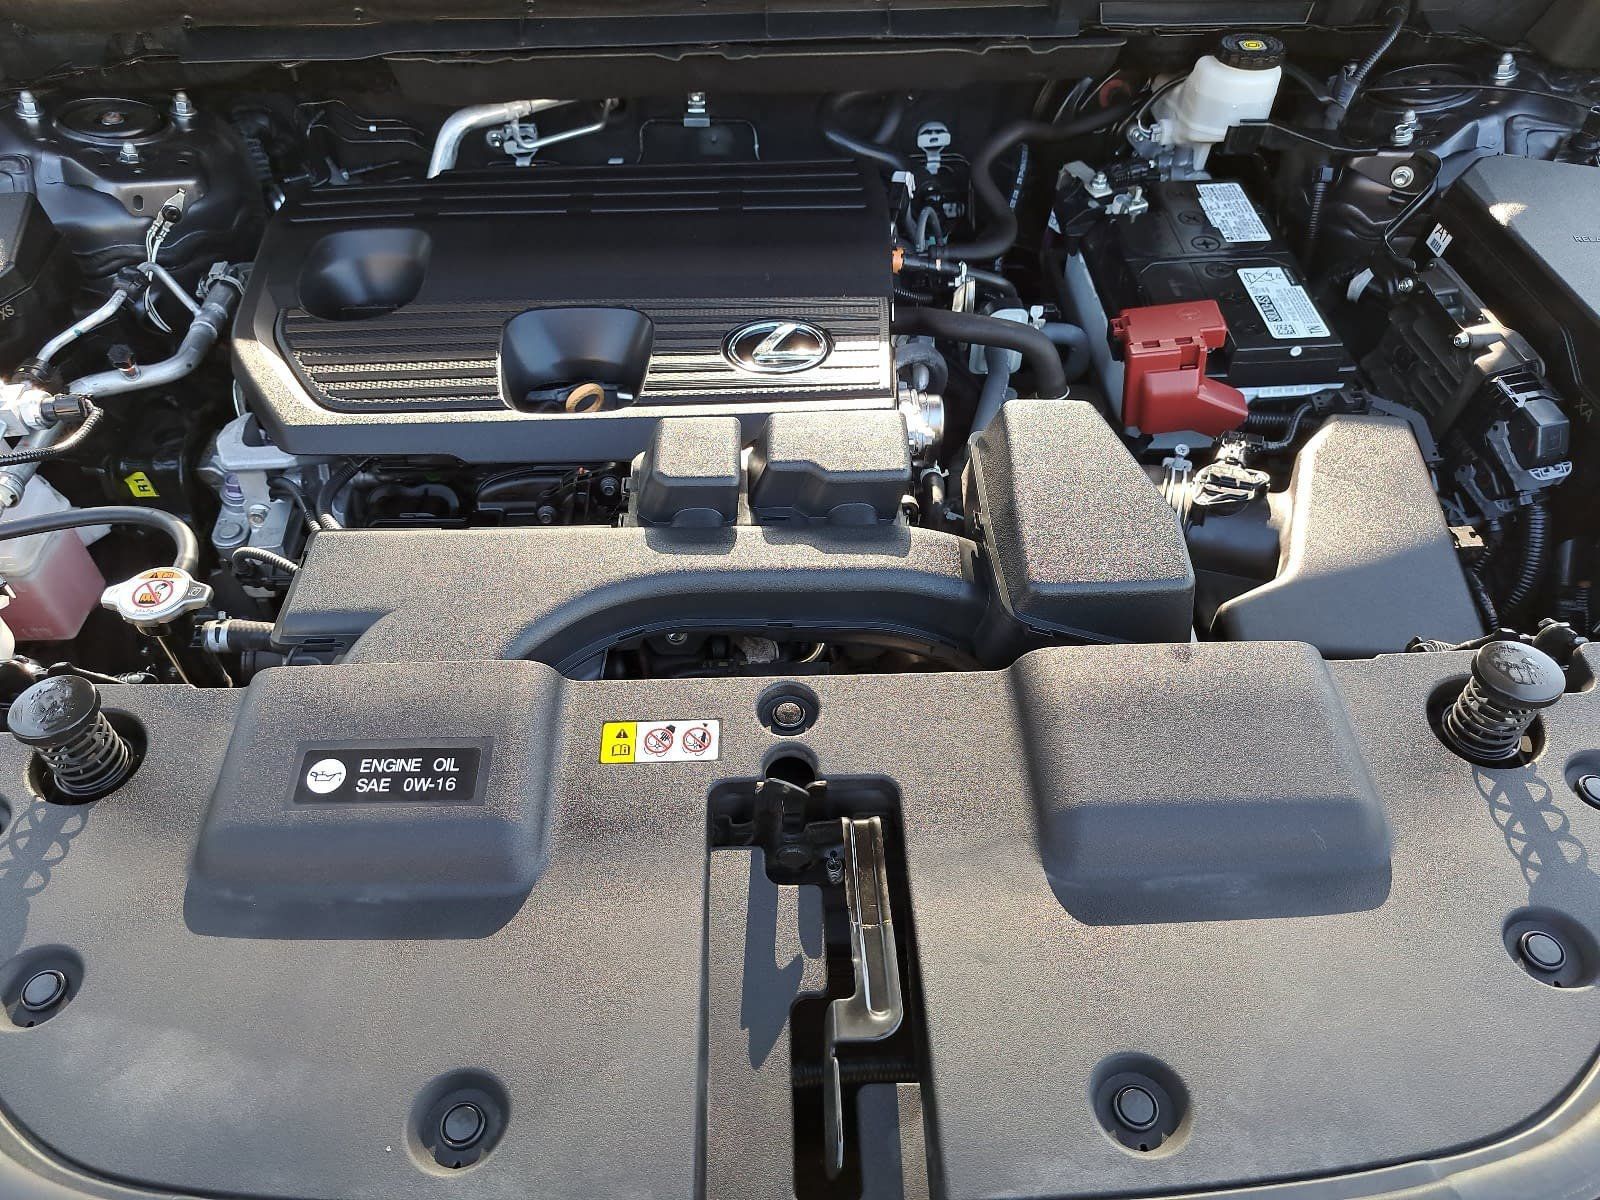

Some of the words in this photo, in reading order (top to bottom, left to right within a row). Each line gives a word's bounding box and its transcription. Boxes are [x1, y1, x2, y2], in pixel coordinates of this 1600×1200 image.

[359, 757, 423, 773] ENGINE
[432, 757, 460, 772] OIL
[355, 778, 391, 793] SAE
[403, 777, 457, 792] 0W-16
